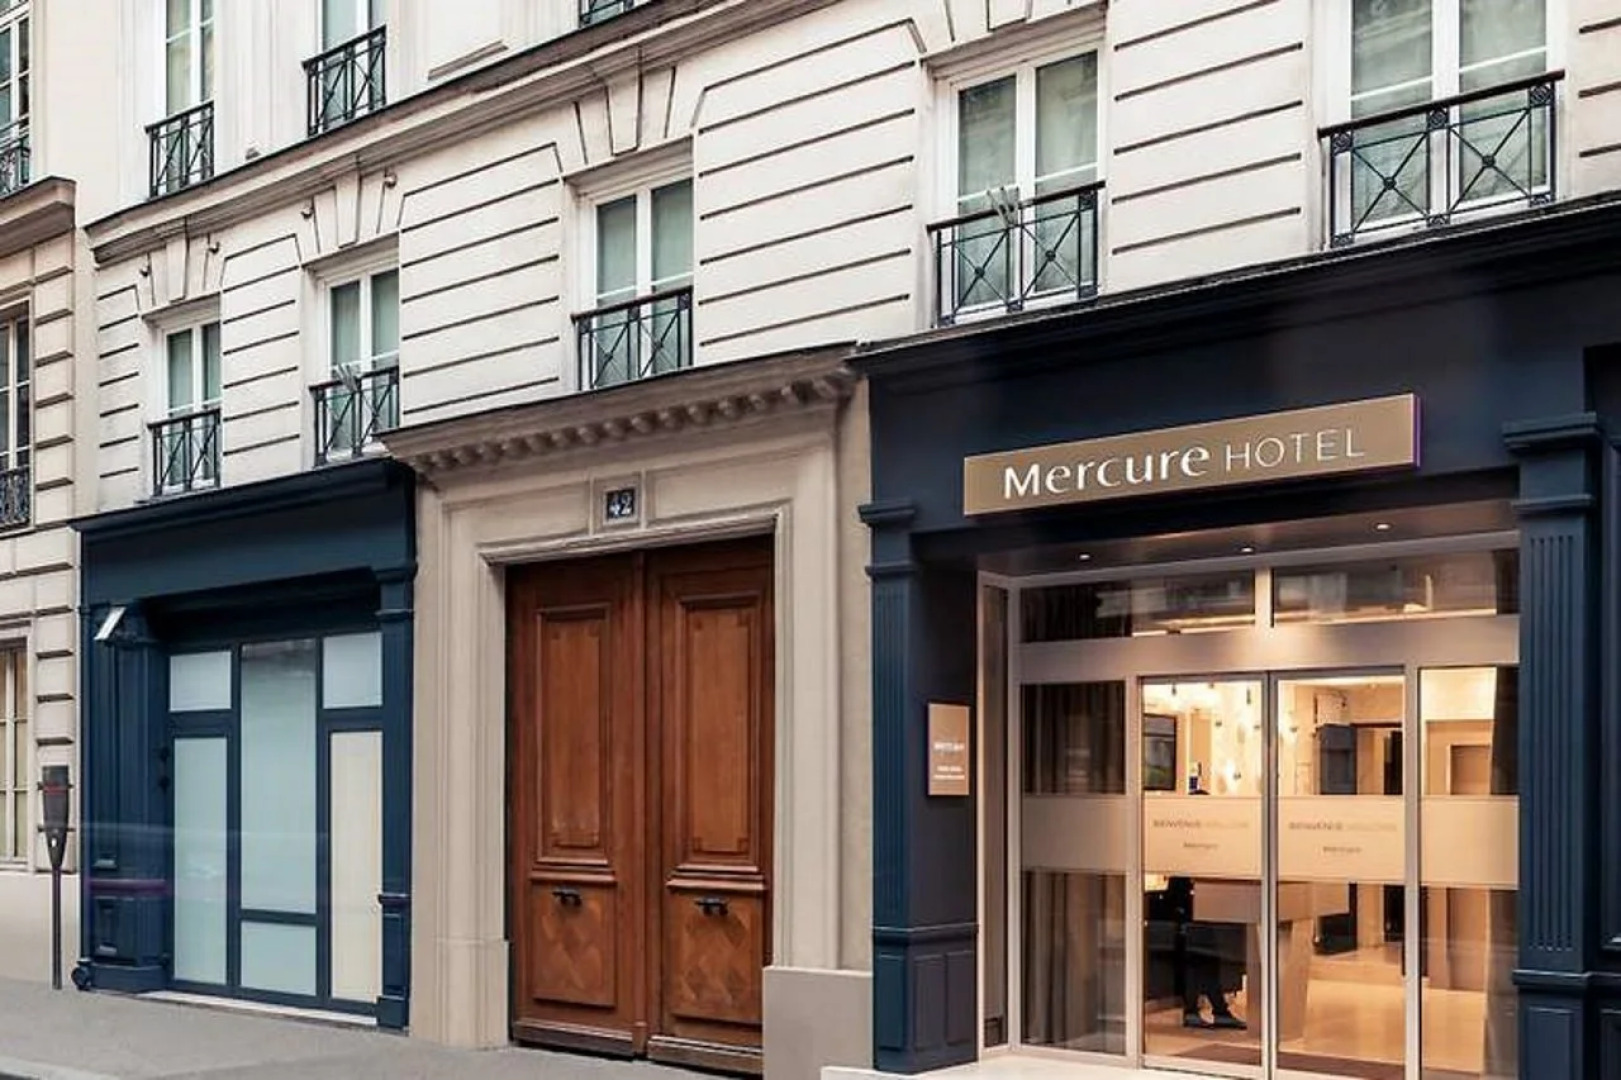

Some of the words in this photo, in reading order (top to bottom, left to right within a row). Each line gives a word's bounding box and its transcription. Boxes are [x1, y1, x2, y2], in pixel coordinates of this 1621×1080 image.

[1002, 444, 1210, 499] Mercure
[1225, 428, 1366, 472] HOTEL
[608, 491, 632, 516] 42
